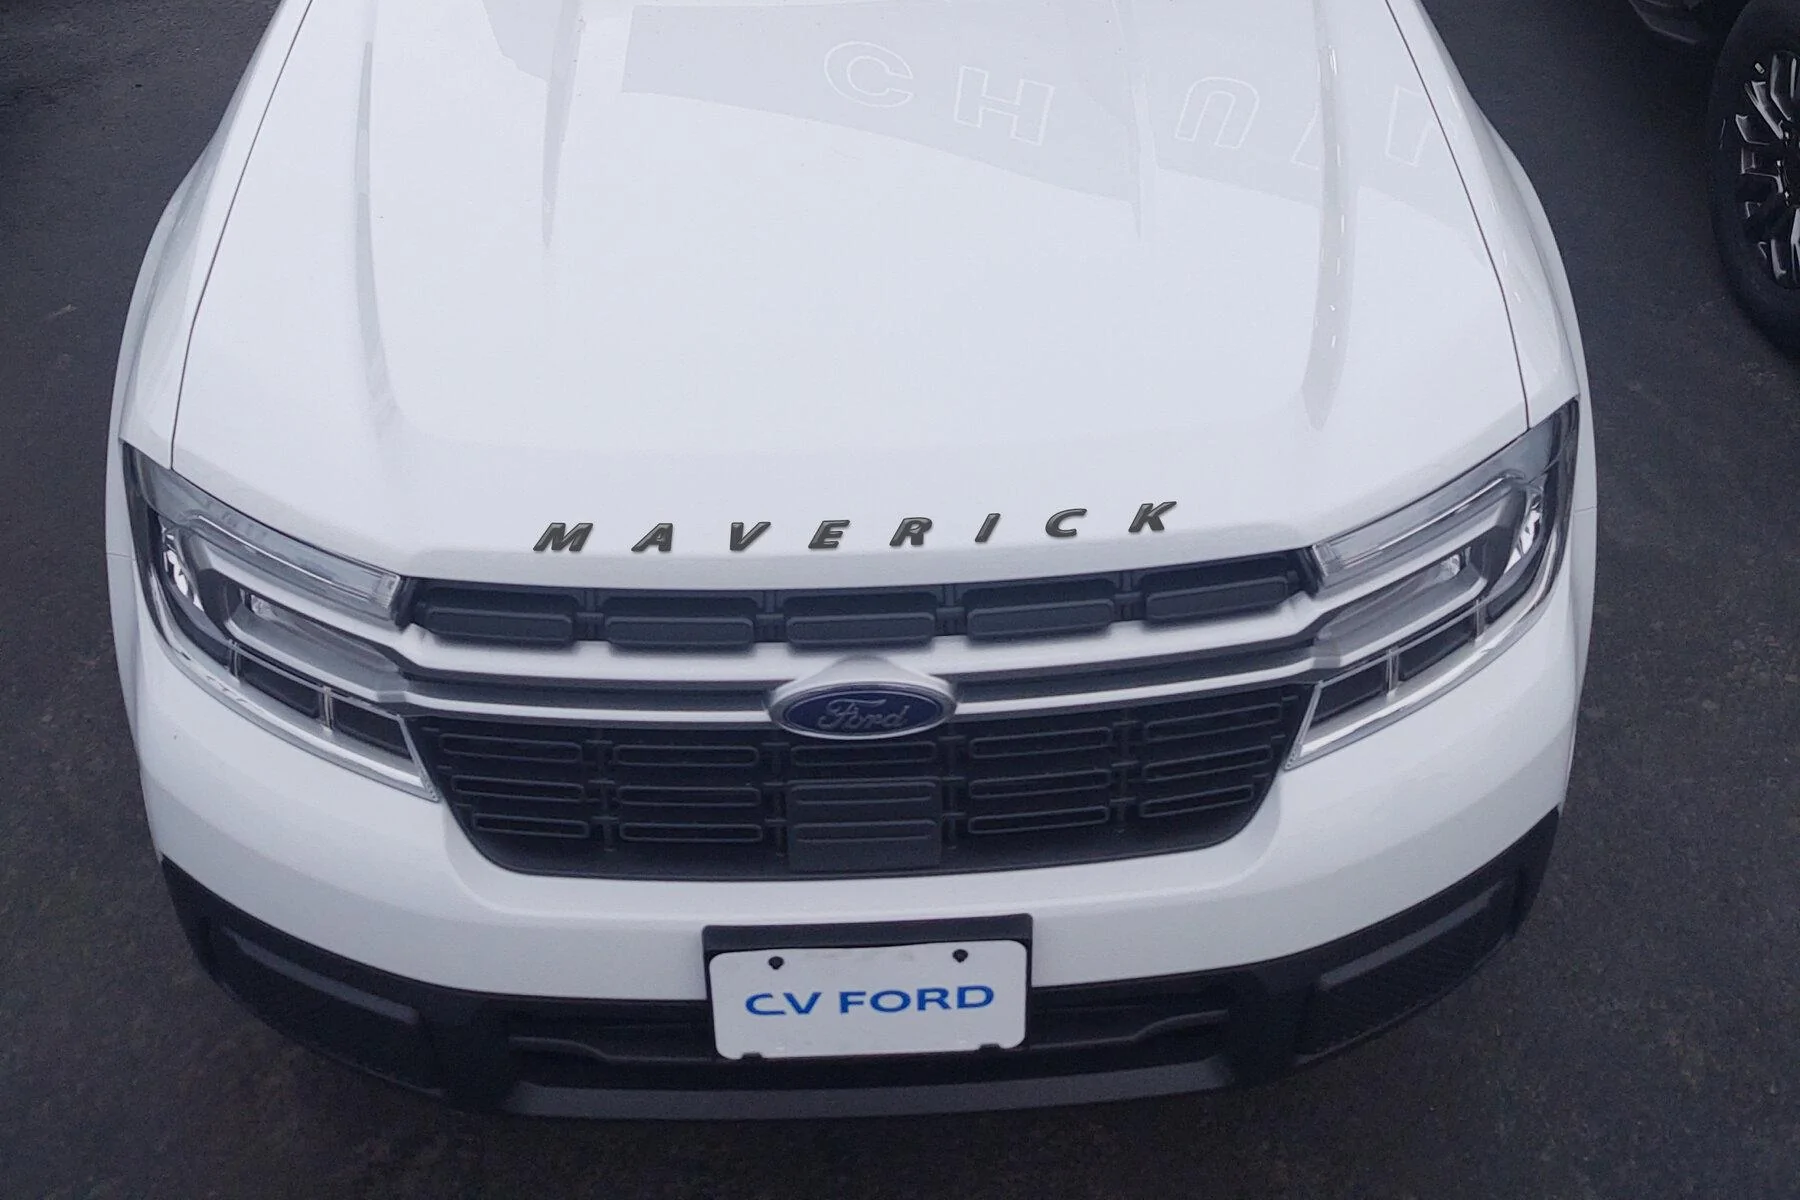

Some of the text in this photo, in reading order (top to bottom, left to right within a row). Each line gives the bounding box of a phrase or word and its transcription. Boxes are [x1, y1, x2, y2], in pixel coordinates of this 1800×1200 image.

[532, 500, 1177, 553] MAVERICK
[817, 698, 911, 730] Ford
[745, 985, 995, 1016] CV FORD
